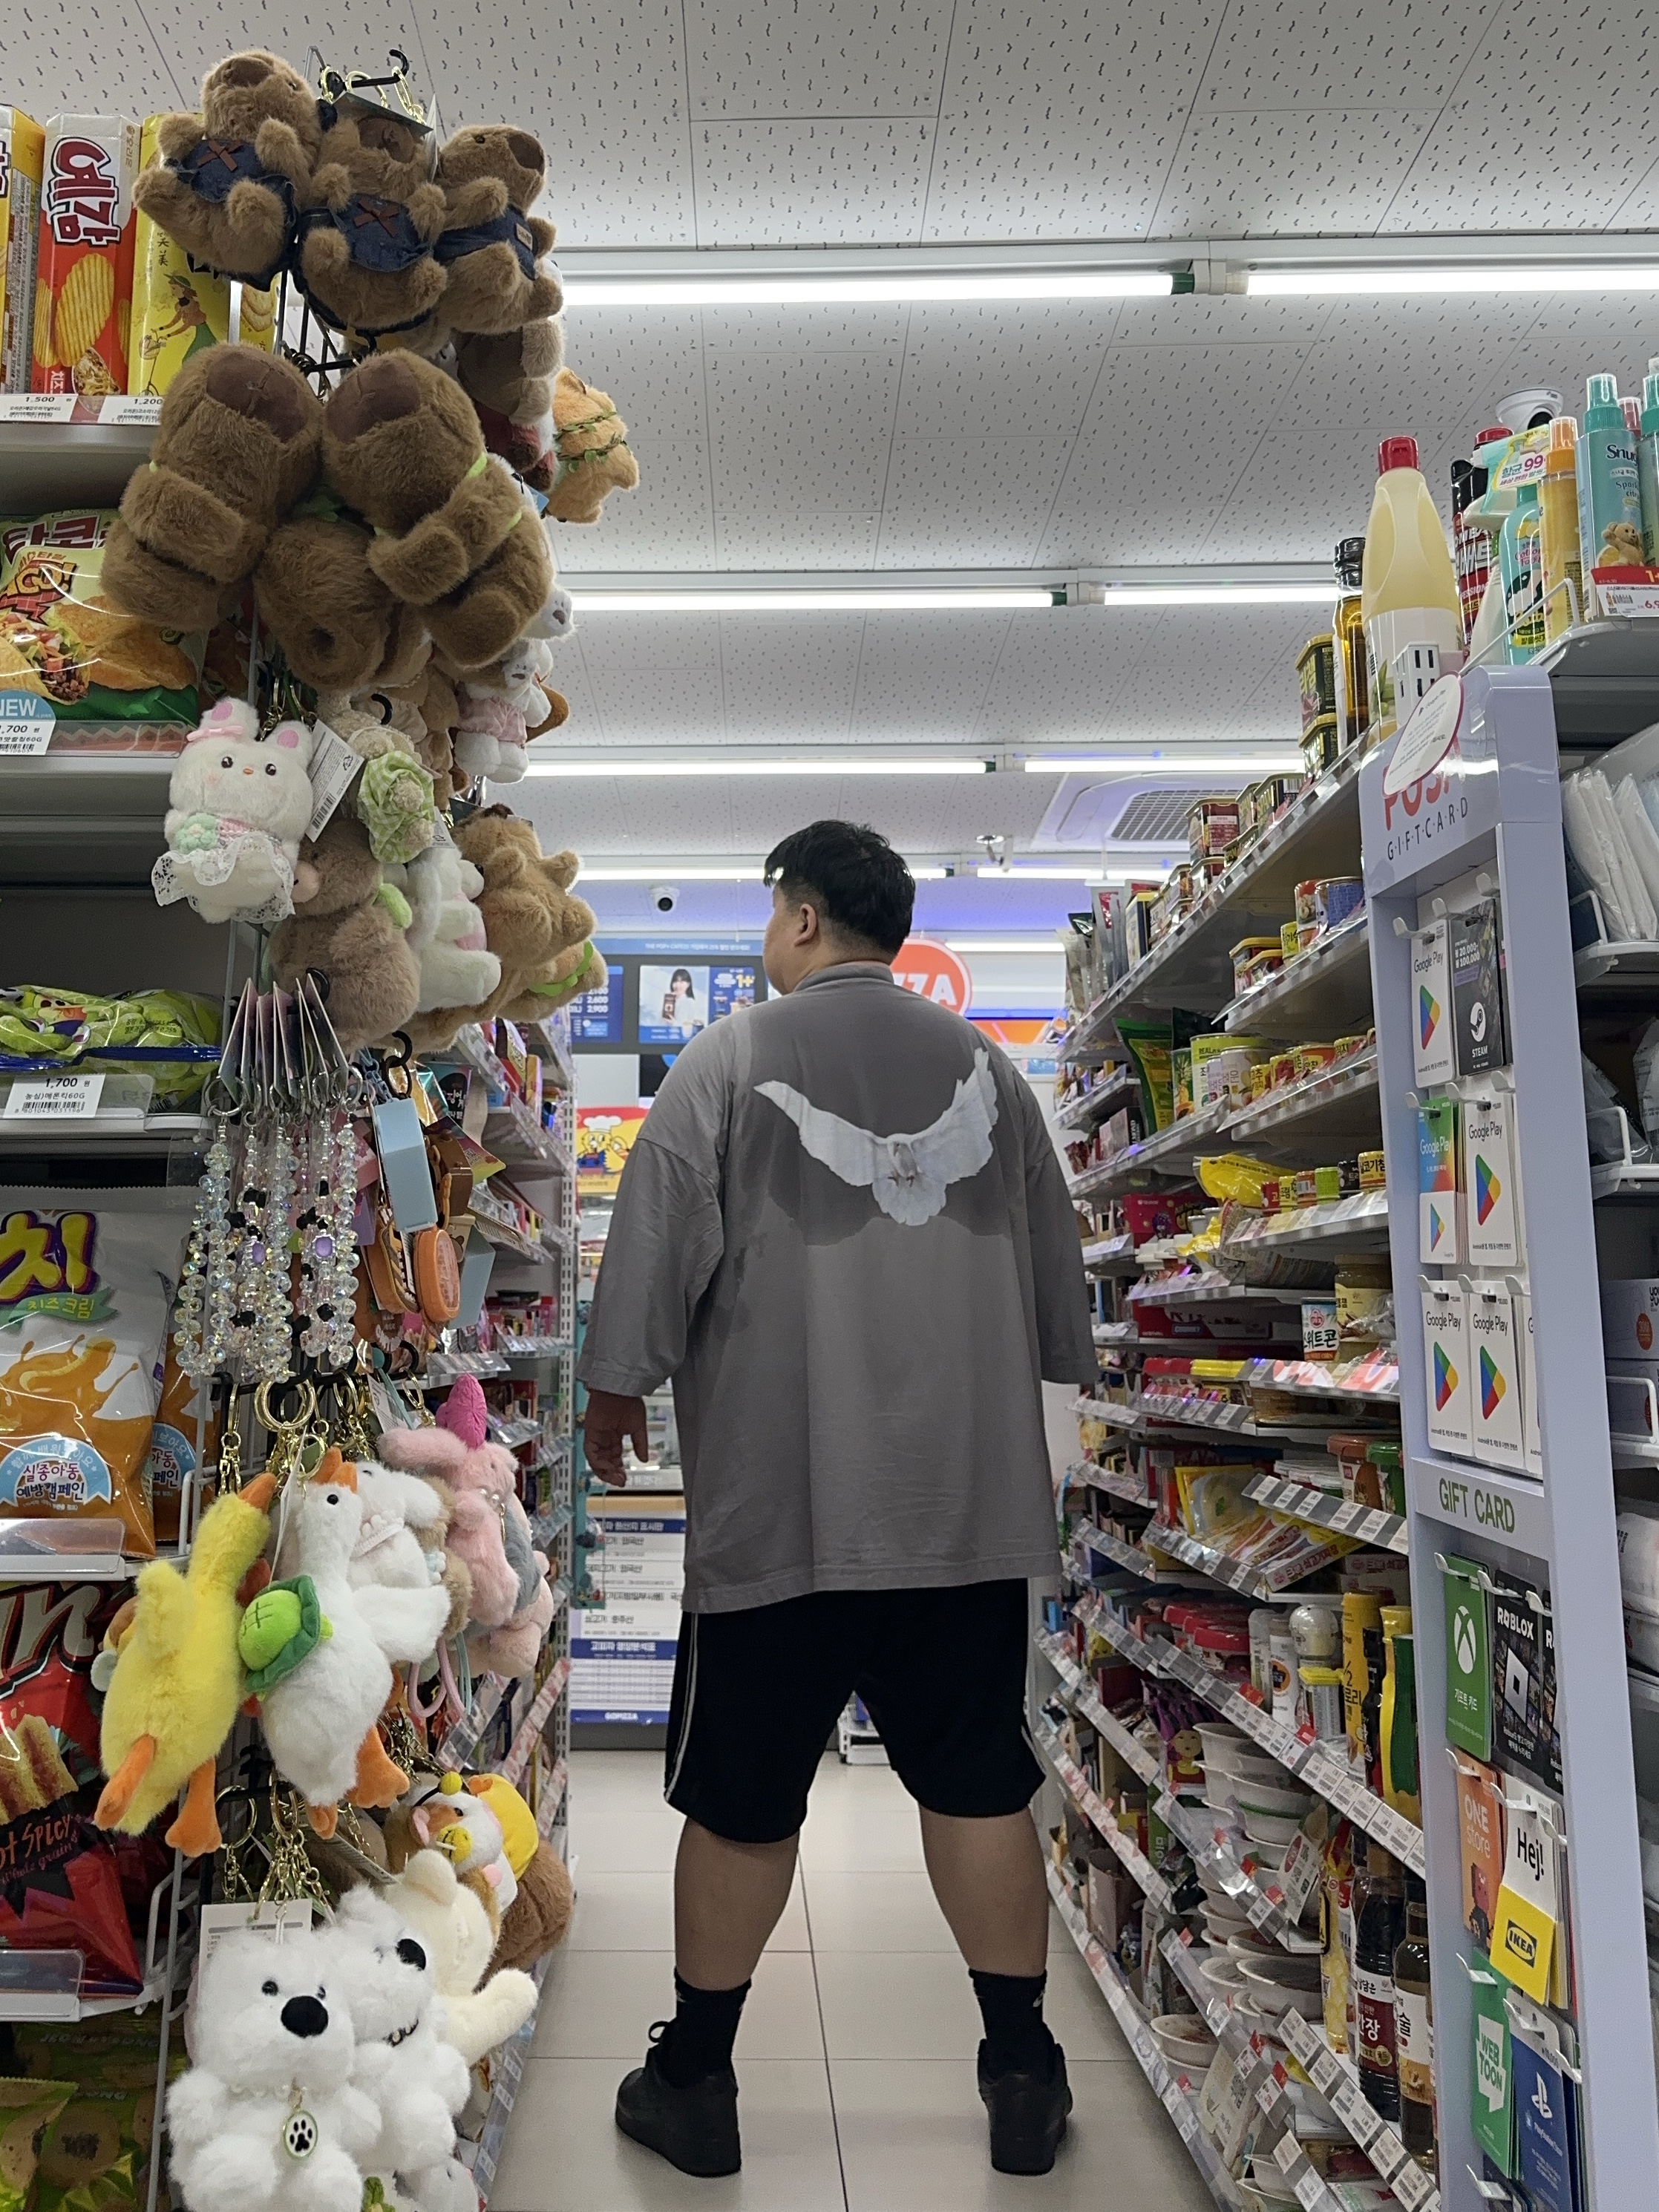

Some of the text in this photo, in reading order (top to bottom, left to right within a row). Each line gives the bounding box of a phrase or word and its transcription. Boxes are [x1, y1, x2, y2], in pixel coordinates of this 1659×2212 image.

[50, 139, 120, 245] 예감
[1524, 454, 1546, 473] 99
[0, 724, 28, 734] ,700
[1414, 951, 1444, 973] Google Play
[892, 972, 958, 1007] ZA
[1471, 1045, 1488, 1058] STEAM
[45, 1078, 79, 1089] 1,700
[1468, 1121, 1503, 1142] Google Play
[1420, 1139, 1439, 1158] Google
[28, 1298, 94, 1318] 치즈 크림
[1425, 1311, 1462, 1332] Google Play
[1473, 1313, 1495, 1335] Google
[1495, 1315, 1508, 1336] Play
[23, 1462, 79, 1482] 실종아동
[1439, 1477, 1515, 1534] GIFT CARD
[1497, 1606, 1534, 1641] ROBLOX
[1464, 1793, 1490, 1834] ONE
[1466, 1825, 1491, 1859] store
[1516, 1827, 1545, 1882] Hej!
[1508, 1929, 1536, 1959] IKEA
[1481, 2032, 1500, 2067] WEB
[1479, 2050, 1503, 2092] TOON
